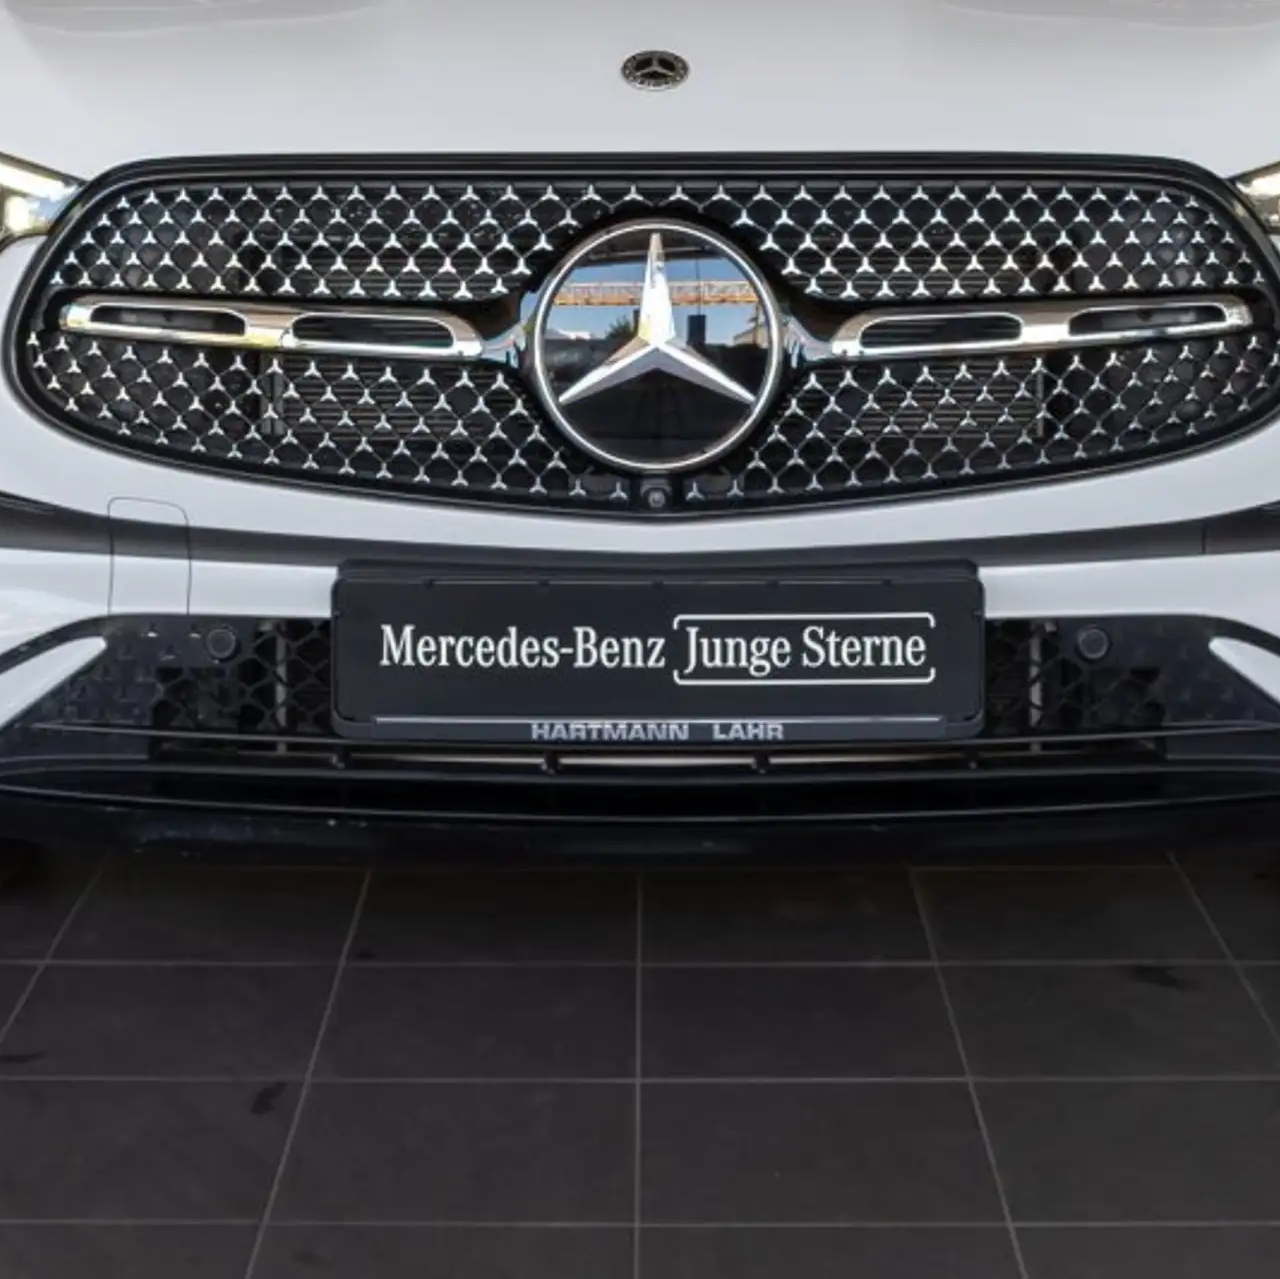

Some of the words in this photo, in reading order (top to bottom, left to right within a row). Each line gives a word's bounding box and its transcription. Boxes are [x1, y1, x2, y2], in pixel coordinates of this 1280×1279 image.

[380, 624, 667, 668] Mercedes-Benz
[684, 625, 792, 677] Junge
[802, 625, 927, 668] Sterne
[531, 722, 690, 741] HARTMANN
[712, 722, 785, 741] LAHR
